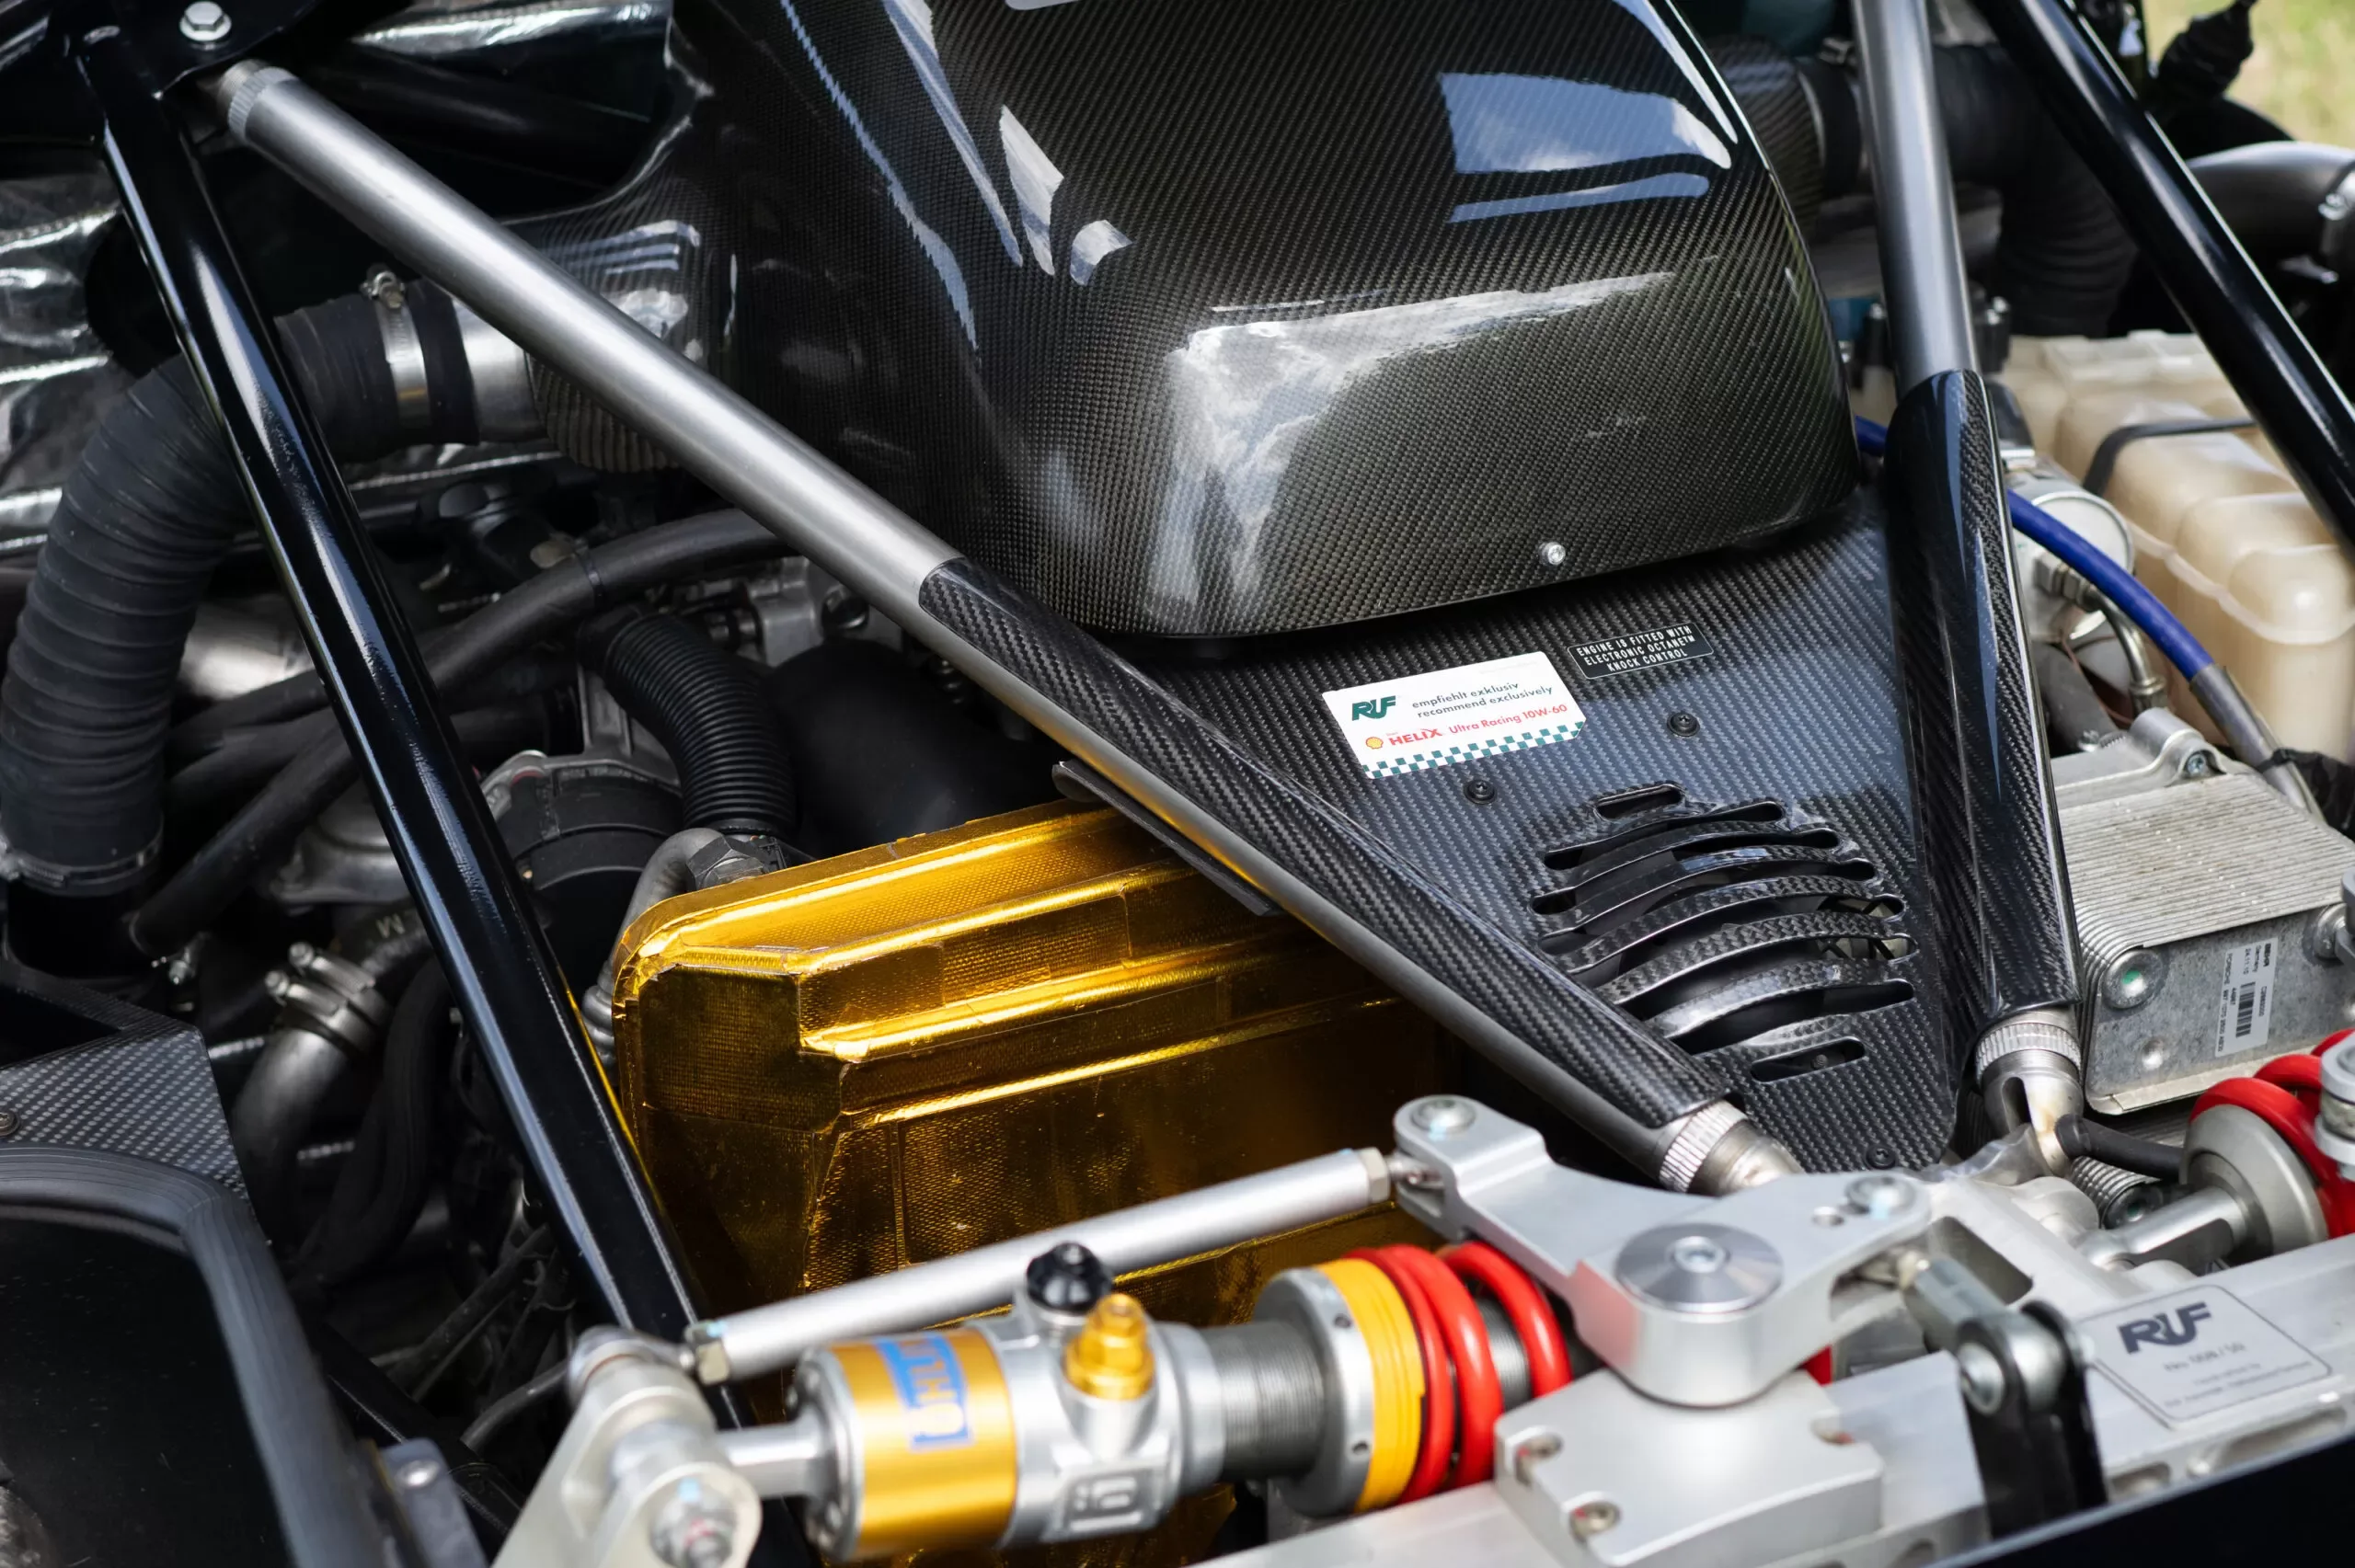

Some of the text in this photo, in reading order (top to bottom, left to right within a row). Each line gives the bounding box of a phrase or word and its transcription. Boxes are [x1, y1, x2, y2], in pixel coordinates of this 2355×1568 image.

[1576, 625, 1693, 657] ENGINE IS FITTED WITH
[1583, 646, 1645, 666] ELECTRONIC
[1606, 647, 1688, 672] KNOCK CONTROL
[1351, 694, 1396, 722] RUF
[1412, 682, 1519, 709] empfiehlt exklusiv
[1418, 686, 1553, 719] recommend exclusively
[1388, 704, 1568, 746] HELIX Ultra Racing 10W-60
[2117, 1301, 2211, 1356] RUF
